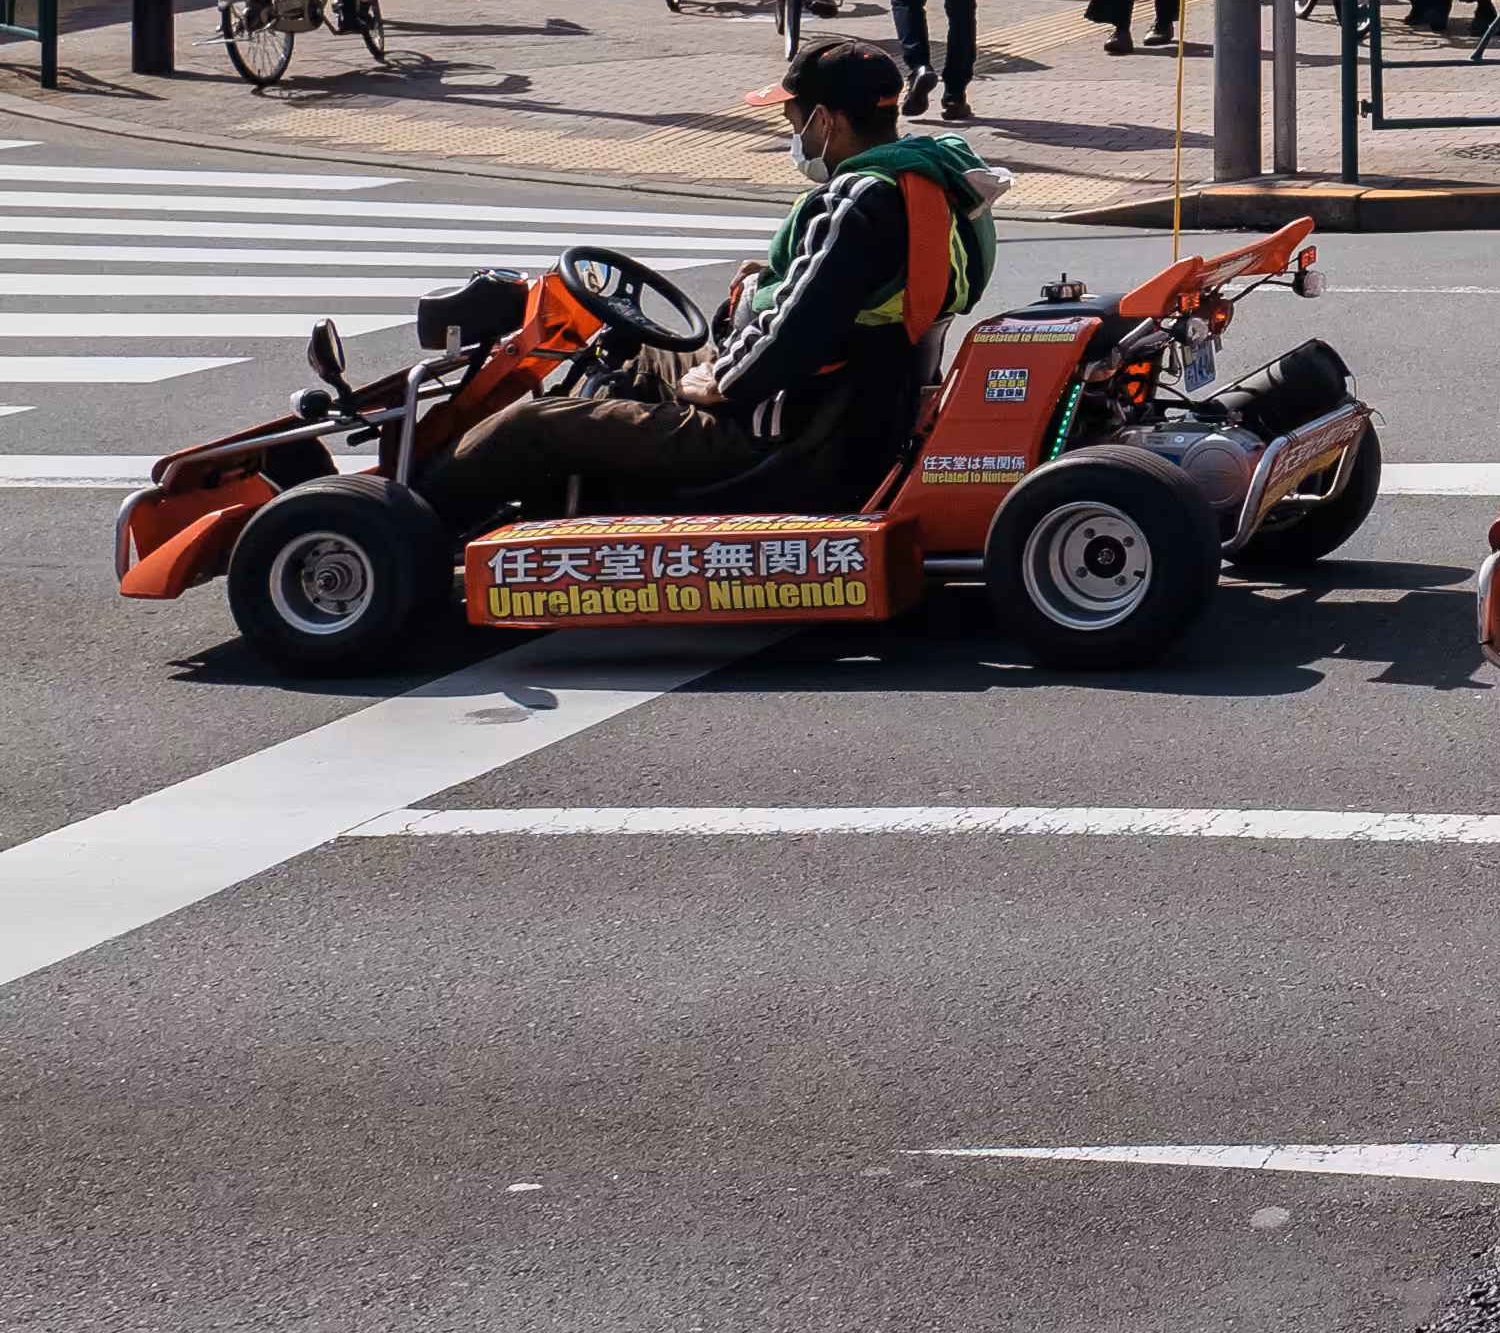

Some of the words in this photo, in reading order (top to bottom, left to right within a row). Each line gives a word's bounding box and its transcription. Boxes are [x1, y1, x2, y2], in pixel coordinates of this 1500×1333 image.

[922, 454, 1026, 471] 任天堂は無関係
[487, 536, 867, 585] 任天堂は無関係
[488, 582, 658, 619] Unrelated
[666, 584, 701, 612] to
[707, 575, 867, 611] Nintendo
